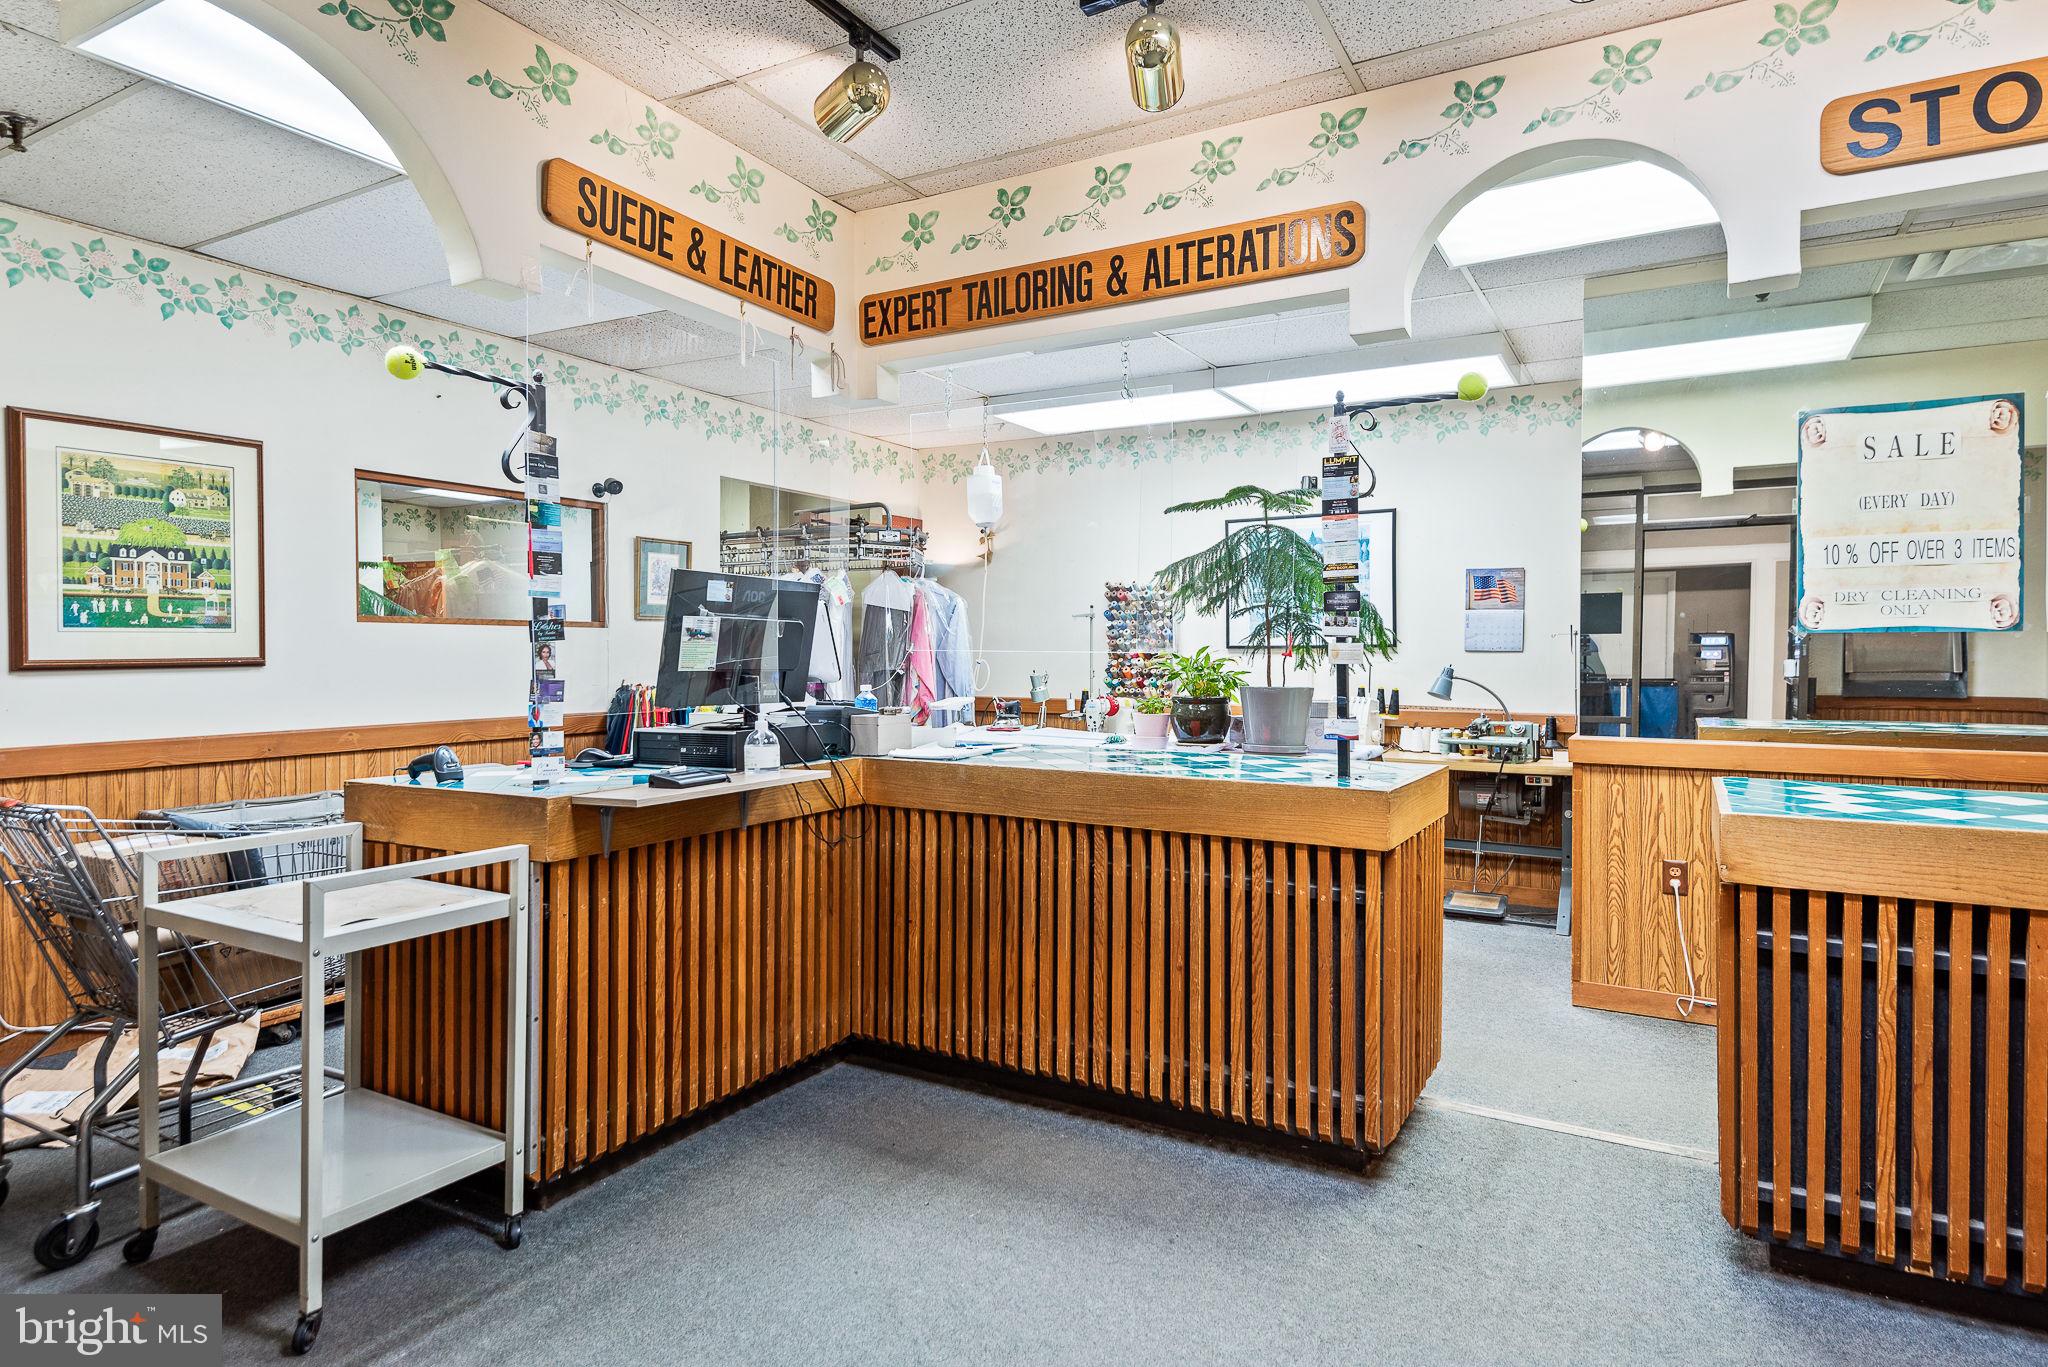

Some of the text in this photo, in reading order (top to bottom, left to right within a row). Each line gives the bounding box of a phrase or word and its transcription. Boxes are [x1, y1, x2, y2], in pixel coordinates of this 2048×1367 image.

[1846, 71, 2043, 158] STO
[577, 176, 818, 320] SUEDE & LEATHER
[863, 209, 1356, 340] EXPERT TAILORING & ALTERATIONS
[1863, 431, 1956, 461] SALE
[1859, 491, 1955, 511] (EVERY DAY)
[1870, 541, 1899, 564] OFF
[1907, 539, 1945, 560] OVER
[1954, 538, 1962, 559] 3
[1972, 536, 2016, 558] ITEMS
[1834, 587, 1982, 603] DRY CLEANING
[1880, 604, 1930, 616] ONLY
